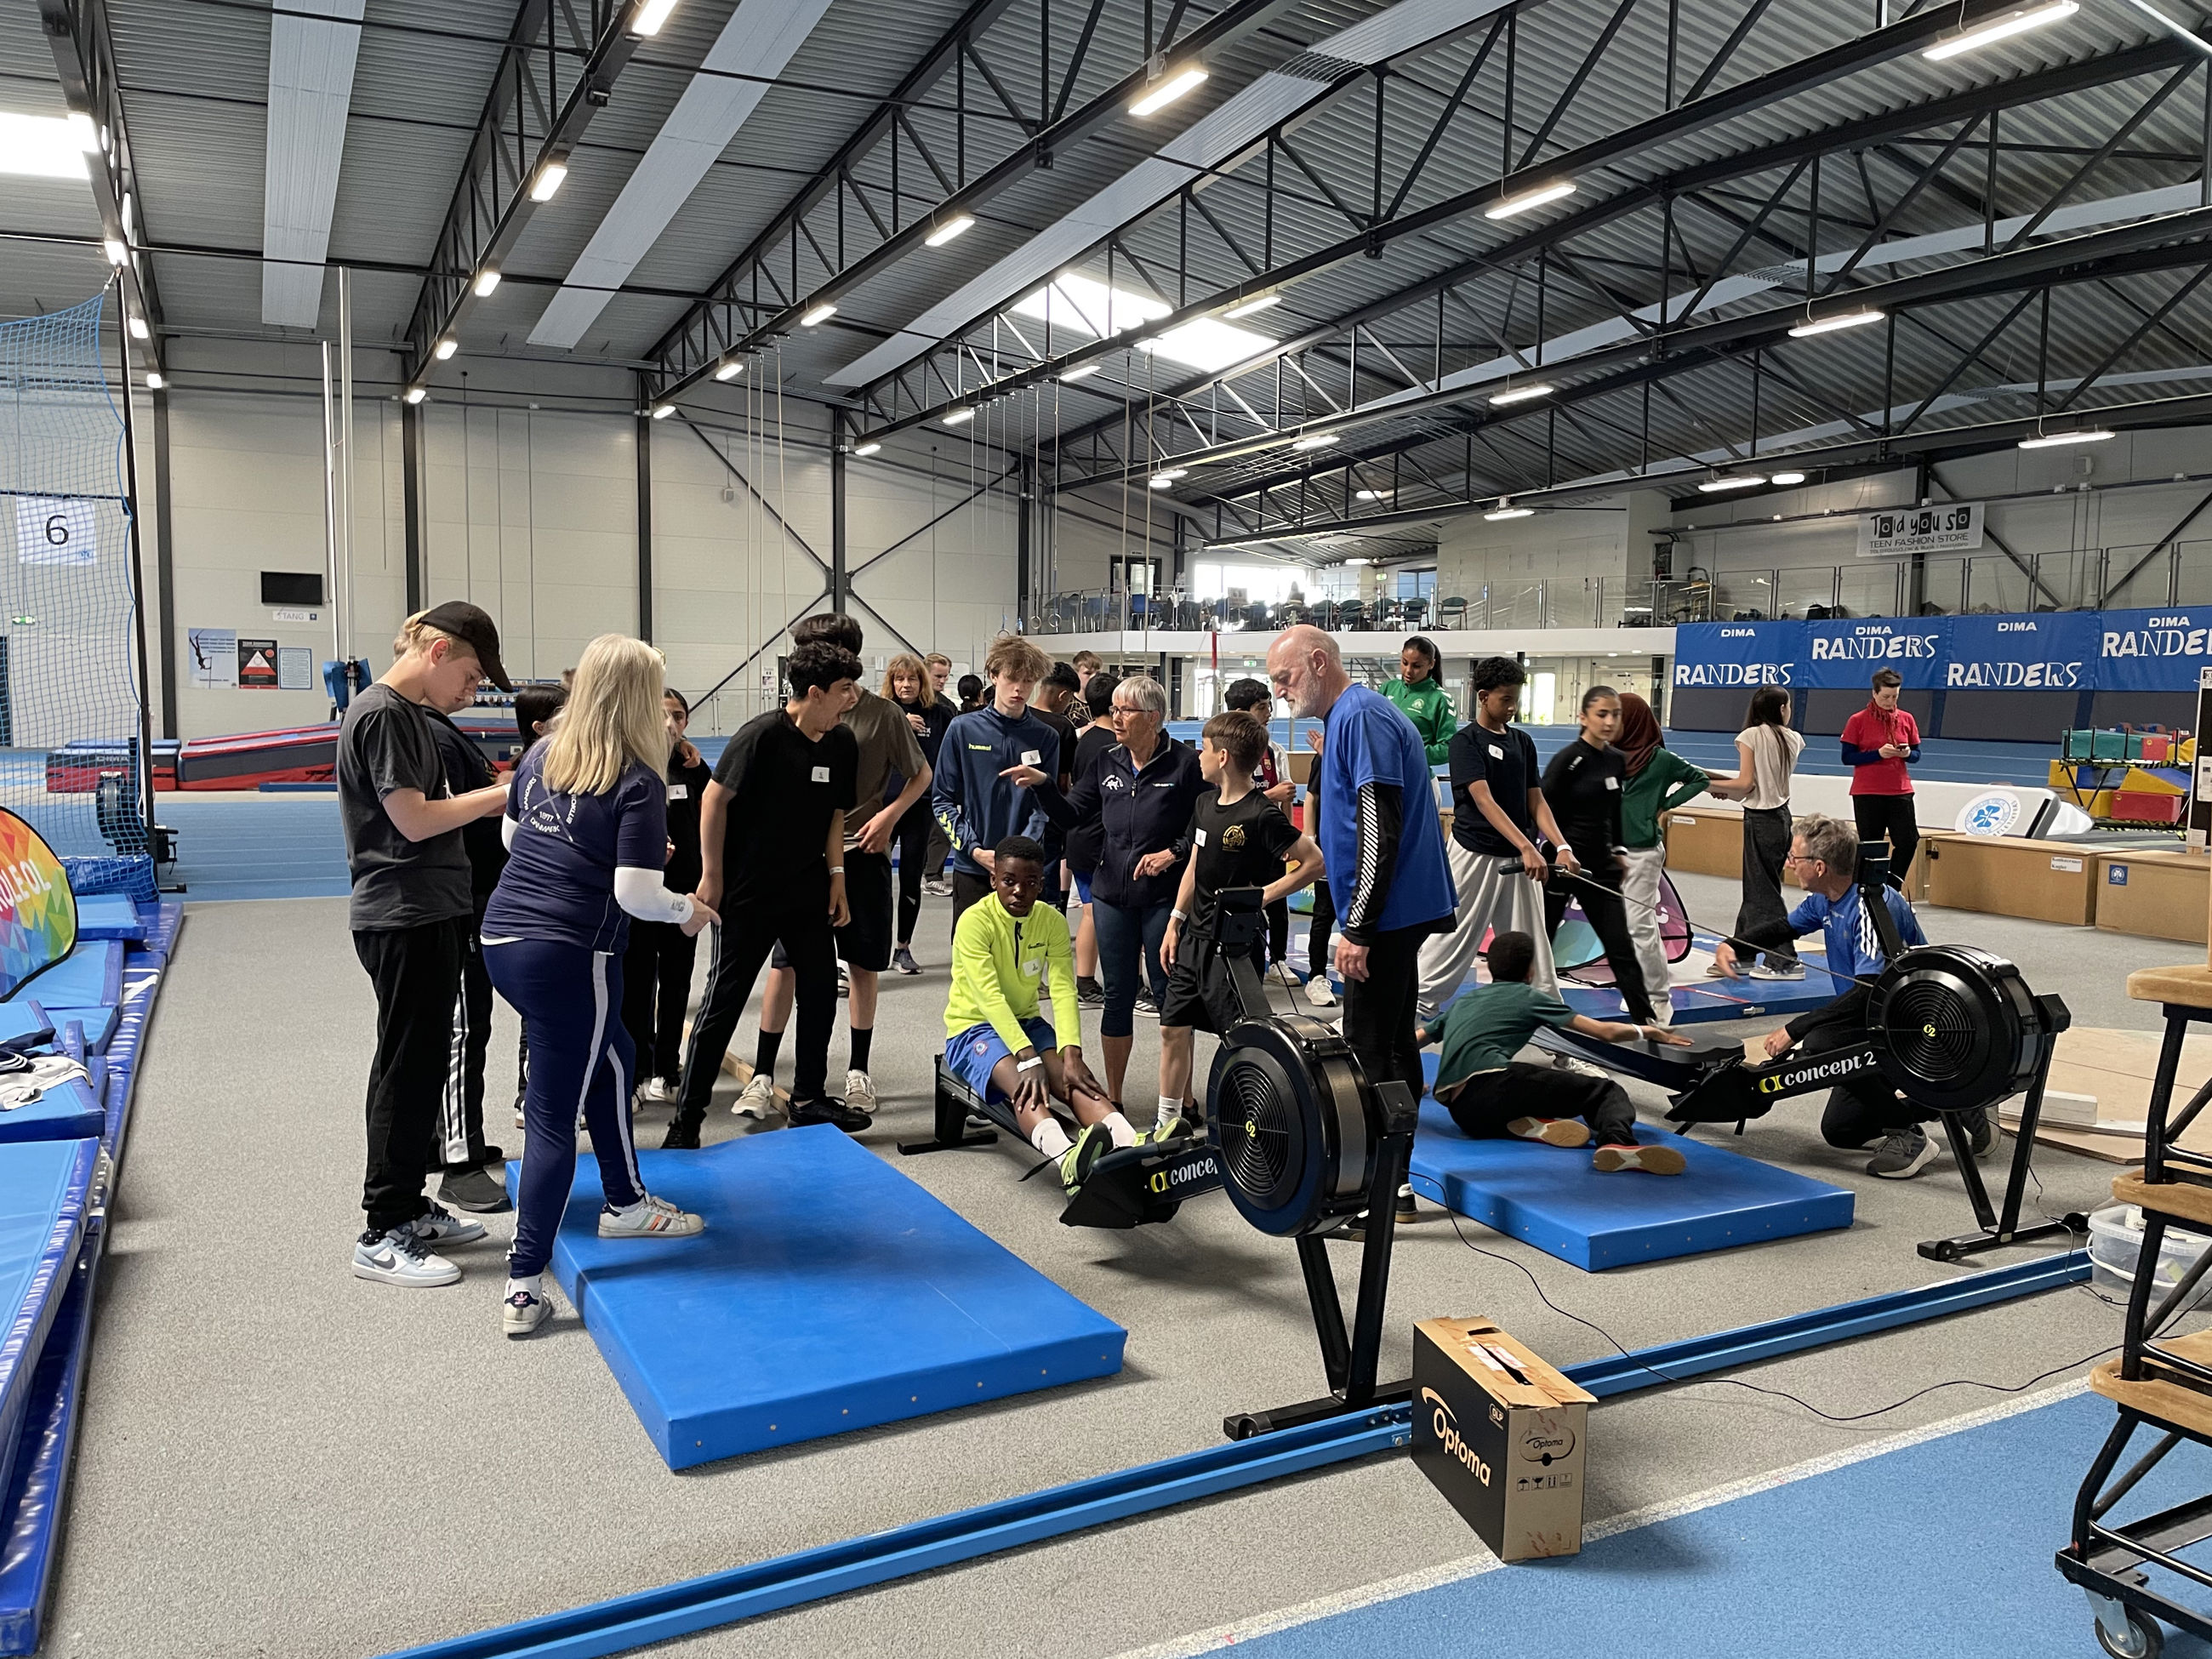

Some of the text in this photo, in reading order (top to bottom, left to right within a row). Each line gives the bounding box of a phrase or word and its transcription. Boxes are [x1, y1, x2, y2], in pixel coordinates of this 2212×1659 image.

[45, 514, 69, 545] 6
[1910, 512, 1941, 536] you
[1870, 533, 1970, 549] TEEN FASHION STORE
[1855, 625, 1893, 636] DIMA
[1997, 621, 2038, 632] DIMA
[2147, 616, 2191, 628] DIMA
[1720, 628, 1756, 638] DIMA
[1811, 635, 1939, 660] RANDERS
[1675, 663, 1794, 686] RANDERS
[1947, 661, 2083, 687] RANDERS
[529, 816, 562, 833] DANMARK
[0, 864, 31, 912] OLE
[1923, 1023, 1936, 1037] C2
[1784, 1051, 1878, 1086] concept 2
[1245, 1120, 1257, 1137] C2
[1491, 1406, 1504, 1422] DLP
[1433, 1406, 1492, 1488] Optoma
[1532, 1437, 1564, 1451] Optoma
